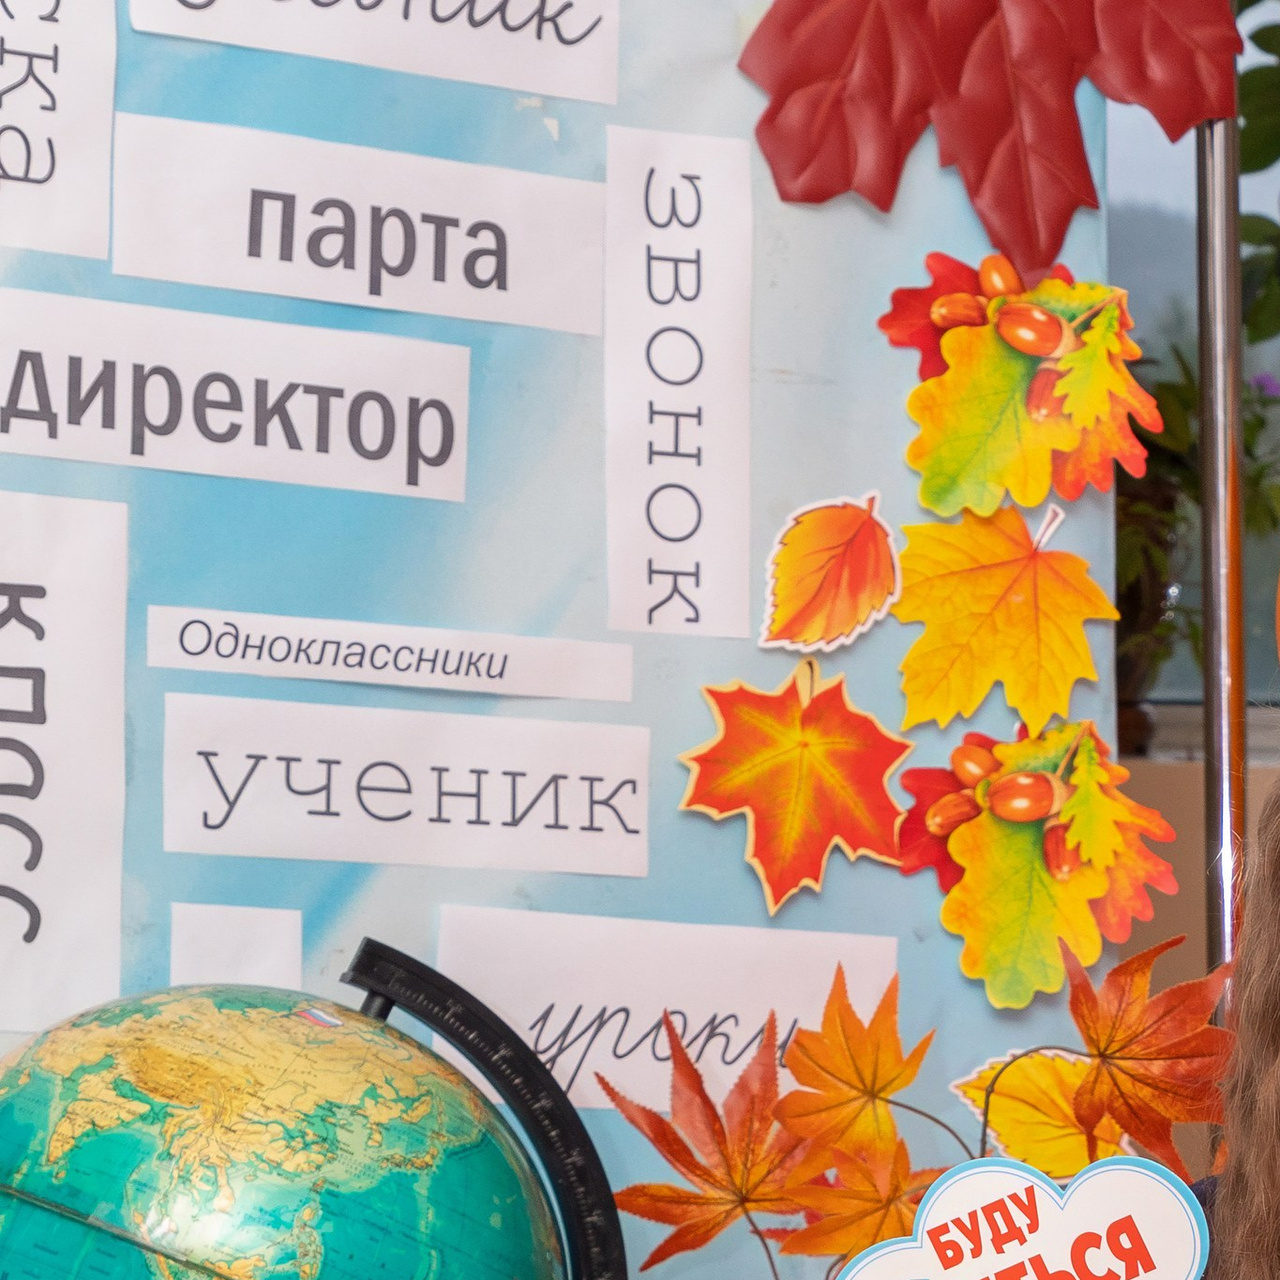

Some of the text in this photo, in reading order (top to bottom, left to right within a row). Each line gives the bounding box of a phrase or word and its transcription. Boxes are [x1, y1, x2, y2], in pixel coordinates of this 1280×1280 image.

[248, 190, 509, 296] парта
[0, 350, 455, 486] директор
[645, 168, 704, 625] звонок
[179, 618, 508, 682] Одноклассники
[197, 750, 641, 836] ученик
[926, 1185, 1040, 1271] БУДУ
